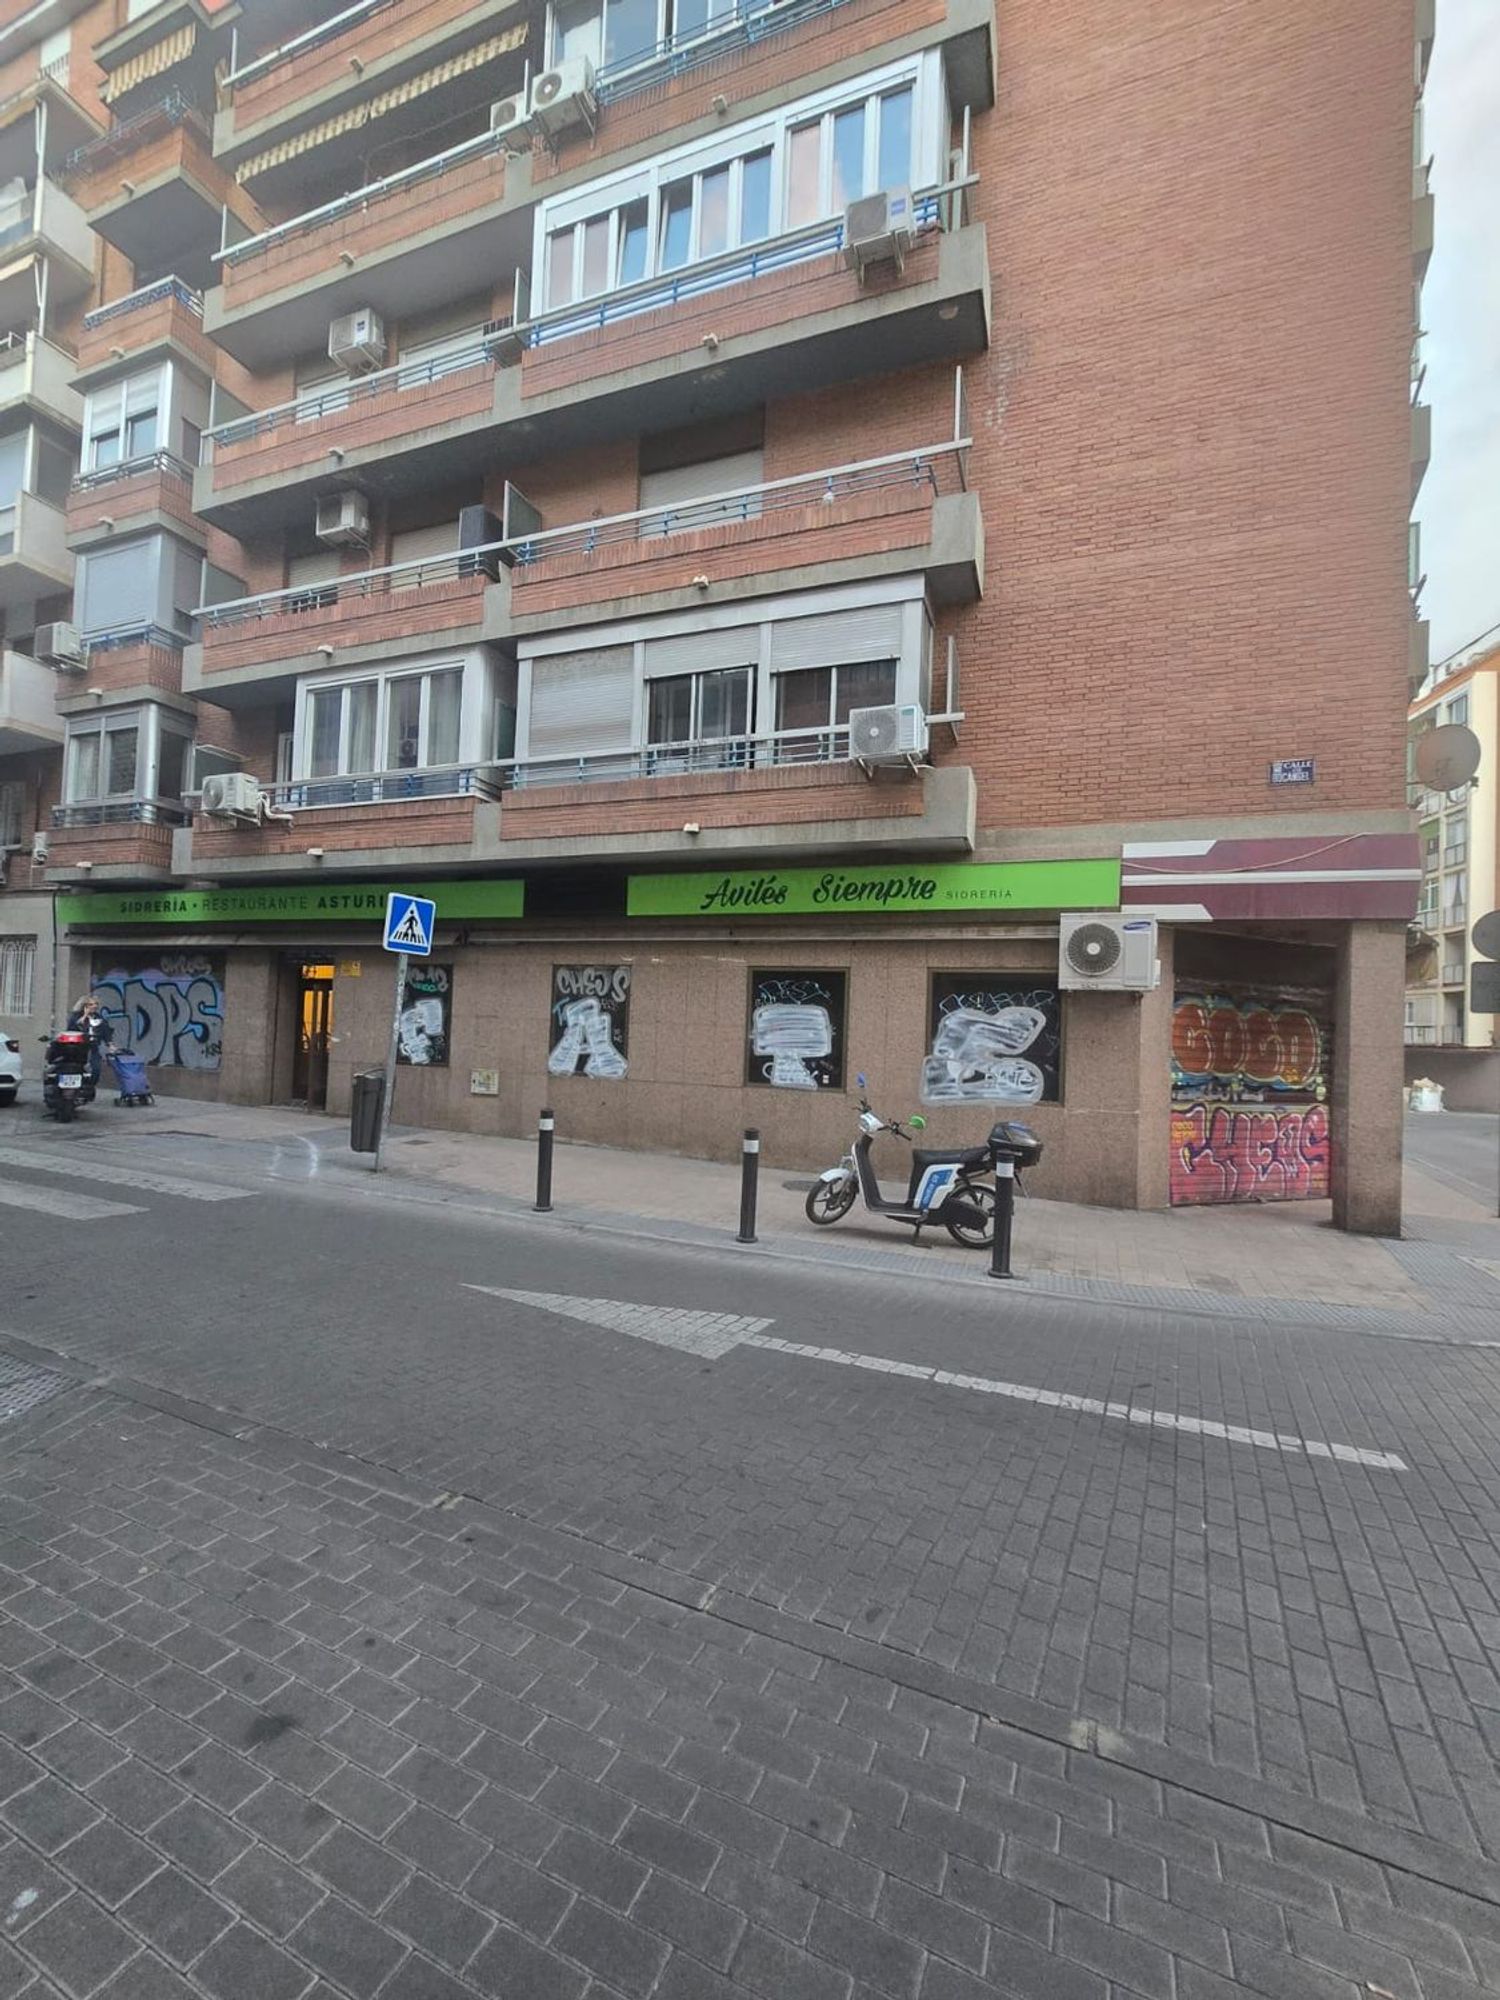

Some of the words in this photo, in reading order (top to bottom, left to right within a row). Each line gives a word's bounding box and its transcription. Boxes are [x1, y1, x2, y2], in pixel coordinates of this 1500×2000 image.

[1283, 761, 1312, 769] CALLE
[700, 874, 788, 909] Avilés
[812, 873, 938, 904] Siempre
[202, 896, 308, 911] RESTAURANTE
